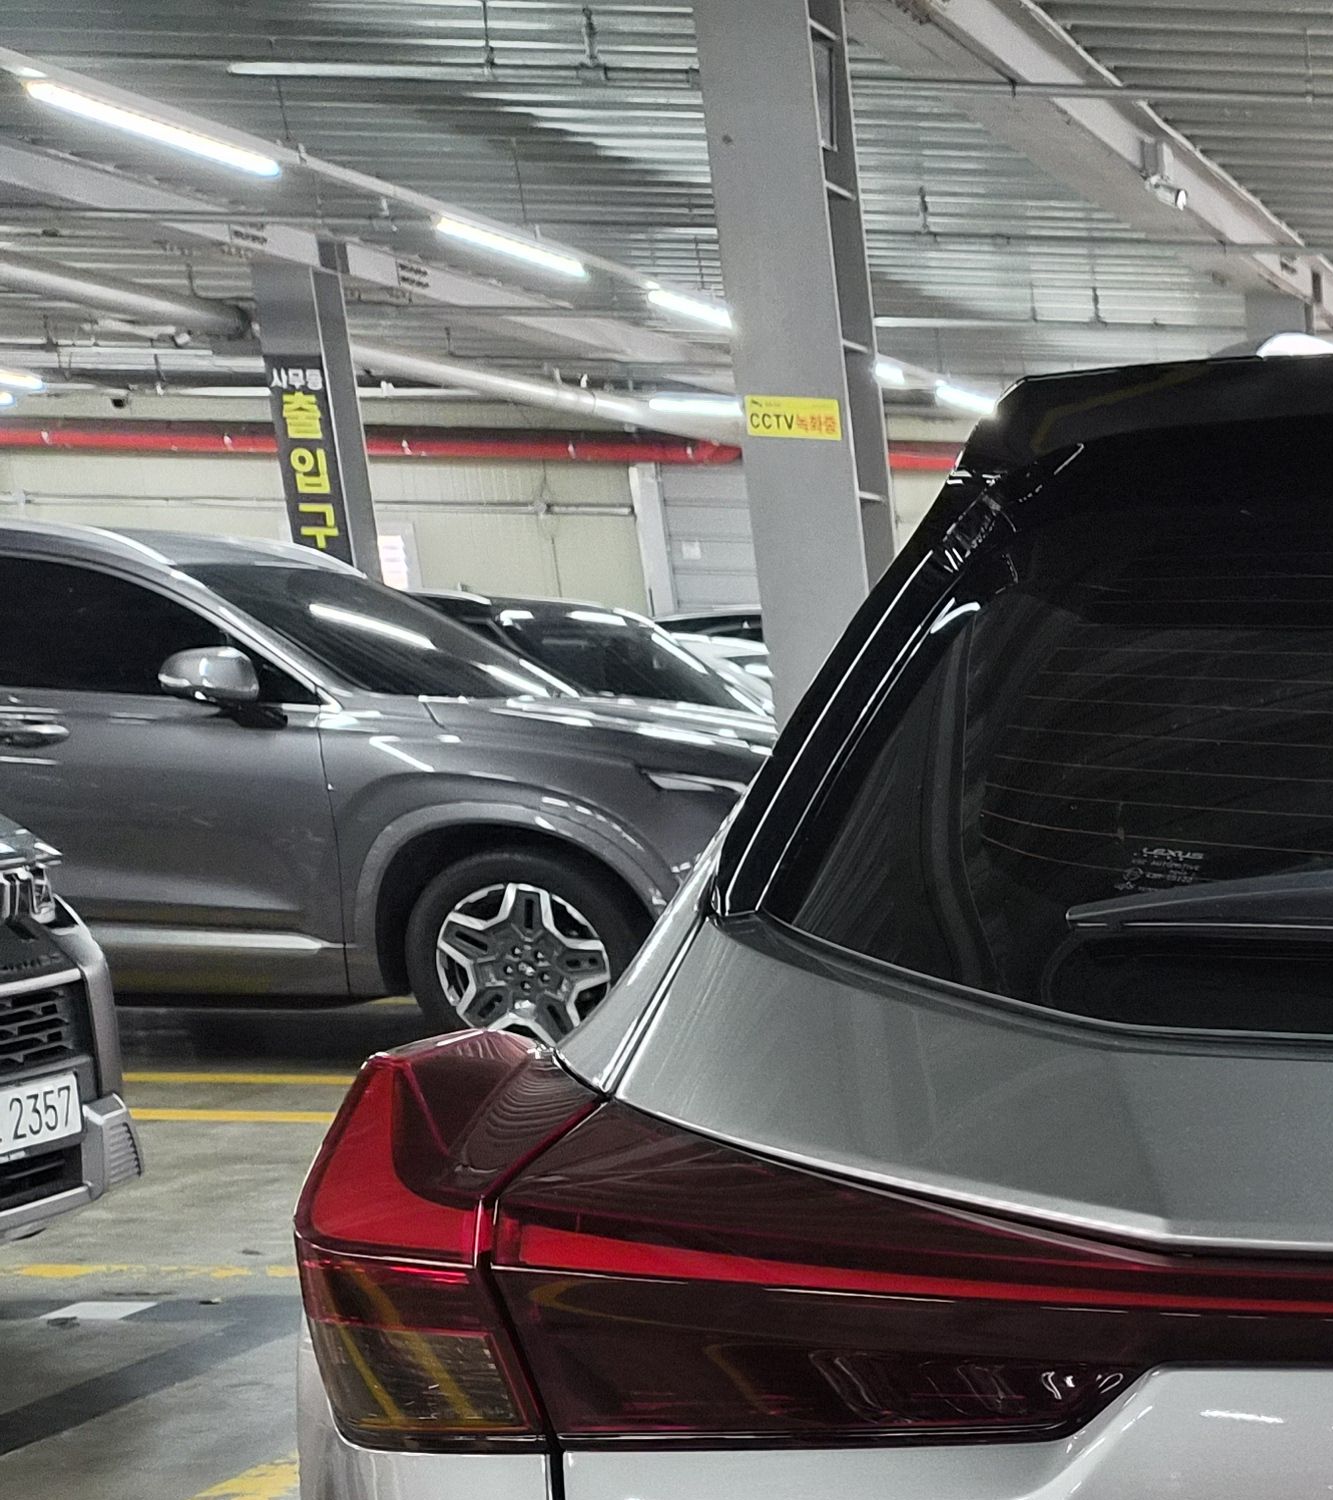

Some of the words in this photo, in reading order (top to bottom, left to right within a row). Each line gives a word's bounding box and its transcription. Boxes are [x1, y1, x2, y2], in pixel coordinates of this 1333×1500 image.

[750, 412, 795, 430] CCTV
[282, 391, 340, 549] 출입구
[9, 1085, 71, 1140] 2357
